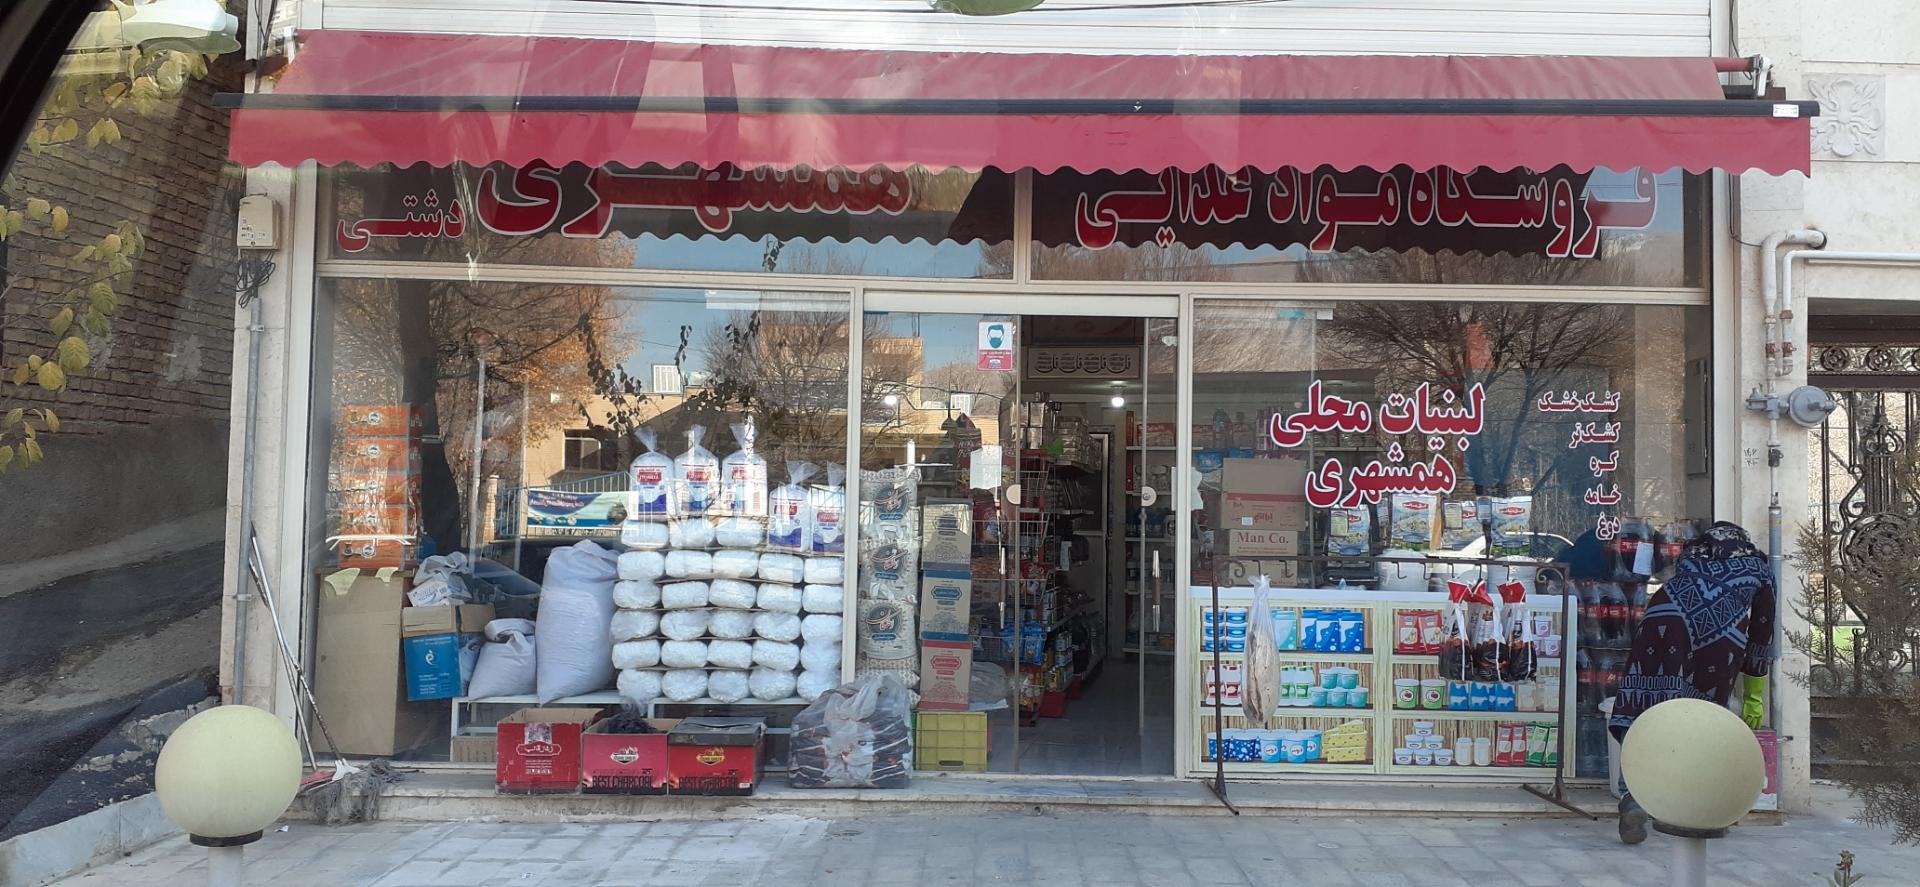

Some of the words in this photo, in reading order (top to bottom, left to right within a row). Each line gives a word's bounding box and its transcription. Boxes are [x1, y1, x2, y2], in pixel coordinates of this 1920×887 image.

[336, 188, 466, 253] دشتی
[476, 159, 912, 239] همشهری
[1267, 164, 1400, 253] مواد
[1408, 165, 1657, 258] فروشگاه
[1270, 379, 1371, 448] محلی
[1378, 381, 1486, 451] لبنیات
[1304, 442, 1458, 509] همشهری
[1584, 483, 1622, 505] خامه
[1589, 450, 1619, 477] کره
[1237, 531, 1264, 543] Man
[1269, 532, 1289, 544] Co.
[1595, 511, 1621, 540] دوغ
[592, 775, 611, 789] BEST
[612, 775, 652, 789] CHARCOAL
